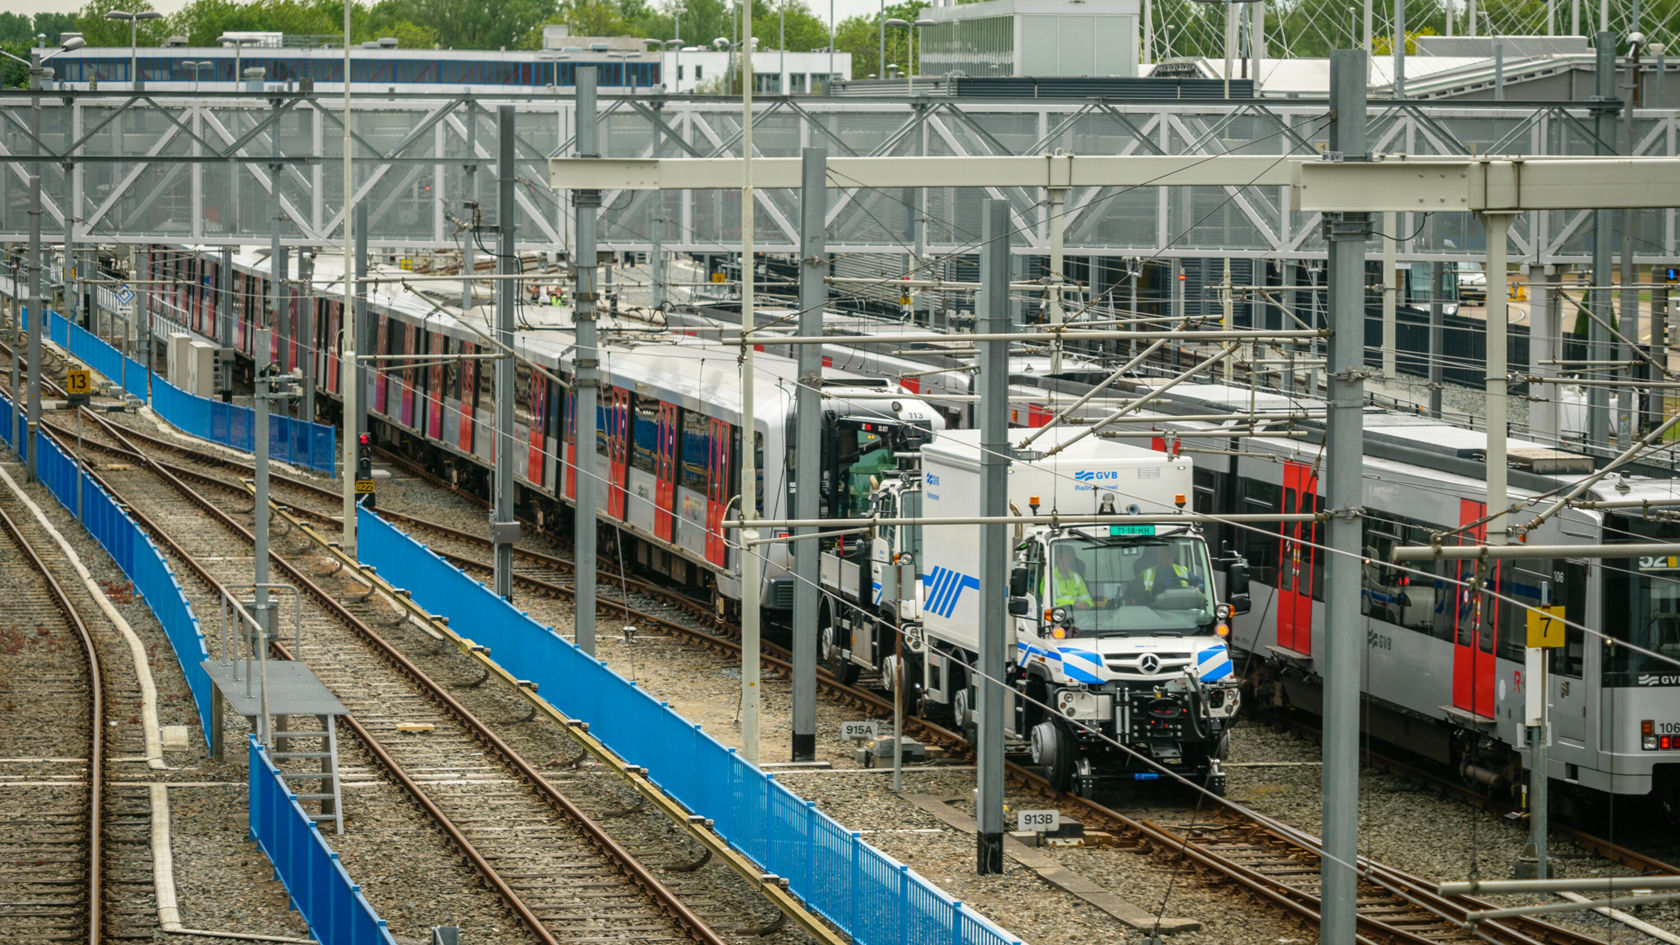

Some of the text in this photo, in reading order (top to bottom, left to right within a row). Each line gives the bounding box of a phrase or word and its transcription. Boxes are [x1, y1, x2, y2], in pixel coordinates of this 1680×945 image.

[70, 374, 86, 389] 13
[908, 412, 924, 420] 113
[1096, 471, 1118, 480] GVB
[1539, 617, 1552, 638] 7
[1379, 634, 1392, 651] GVB
[847, 725, 873, 735] 915A
[1660, 723, 1680, 734] 106
[1024, 814, 1053, 825] 913B
